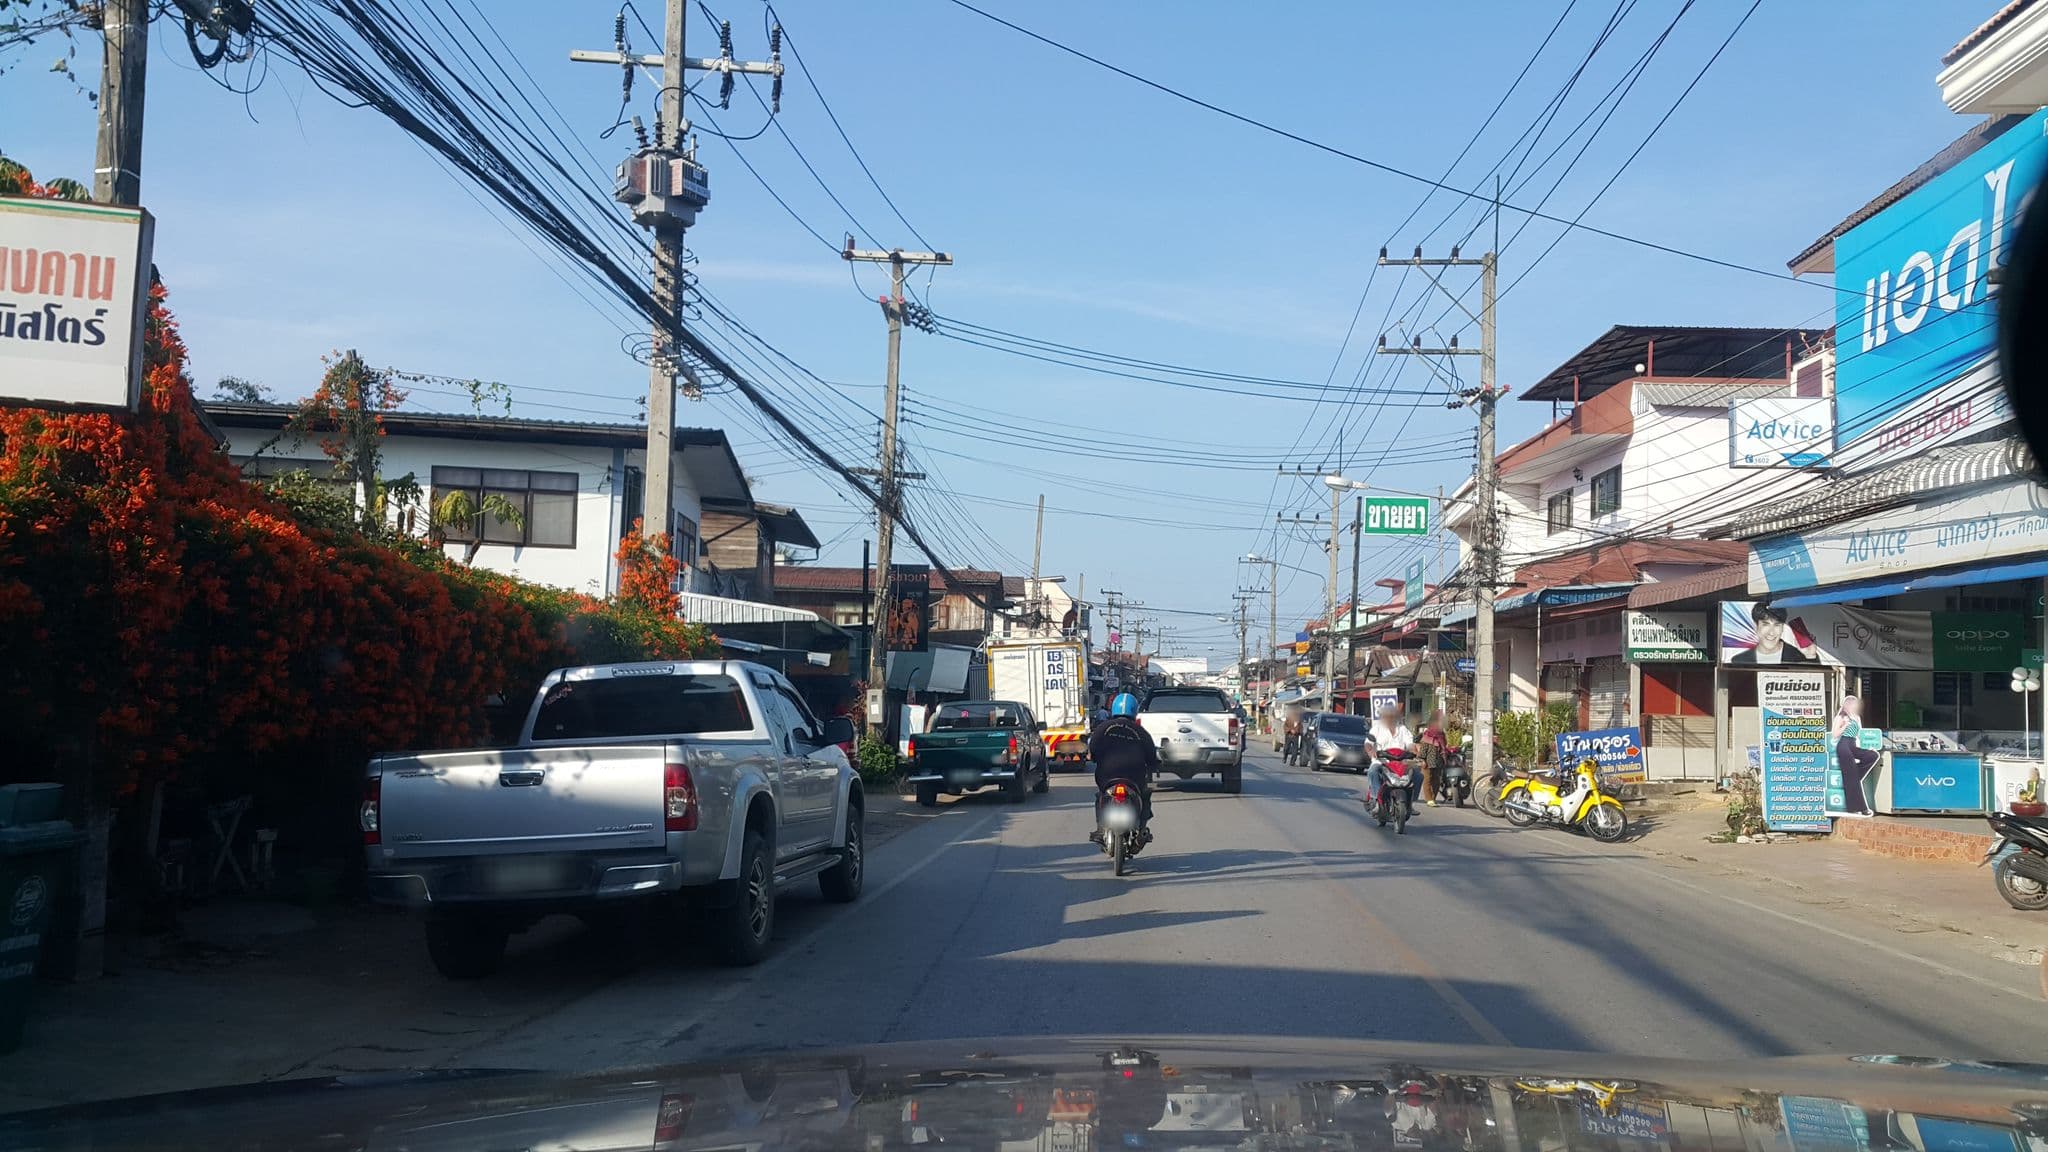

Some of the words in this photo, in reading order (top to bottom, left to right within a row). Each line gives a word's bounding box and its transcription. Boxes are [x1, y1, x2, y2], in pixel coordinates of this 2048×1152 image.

[0, 247, 115, 301] งคาน
[1747, 418, 1822, 441] Advice
[1369, 505, 1426, 529] ขายยา
[1846, 527, 1910, 564] Advice
[1048, 652, 1060, 661] 15
[1633, 649, 1703, 660] ตรวจรักษาโรคทั่วไป
[1765, 679, 1821, 695] ศูนย์ซ่อม
[1915, 774, 1956, 786] vivo
